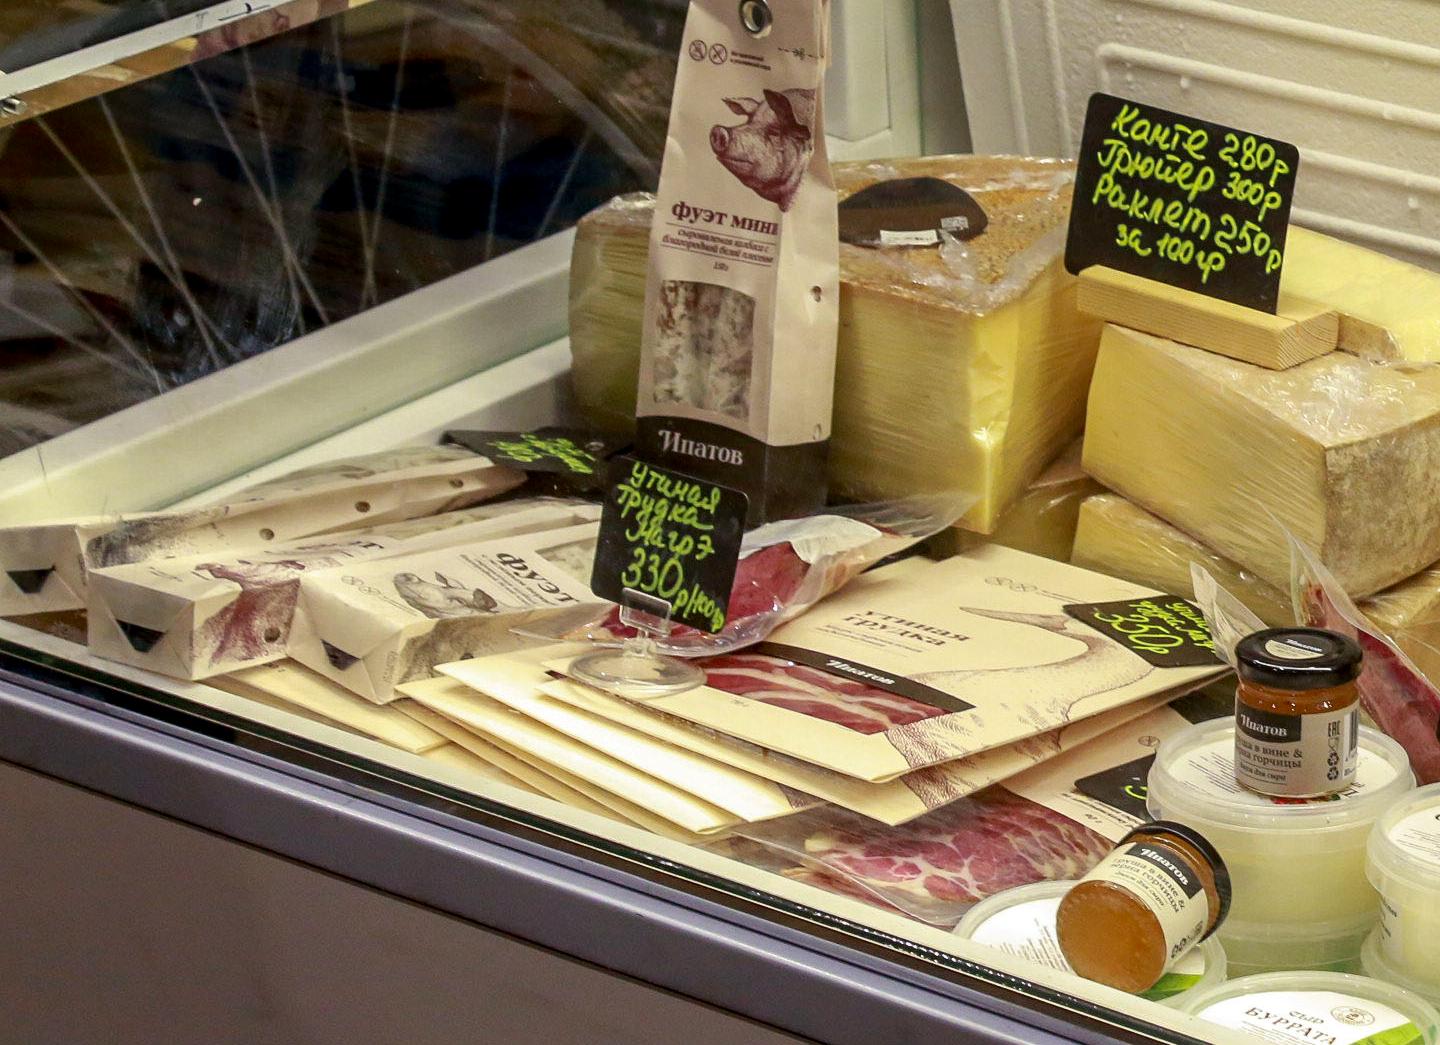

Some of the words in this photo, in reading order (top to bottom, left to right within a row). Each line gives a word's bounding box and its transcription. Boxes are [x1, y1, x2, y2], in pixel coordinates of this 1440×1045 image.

[1219, 133, 1290, 187] 280р
[671, 201, 728, 224] фуэт
[1222, 172, 1281, 222] 300р
[1116, 224, 1151, 256] за
[1157, 233, 1225, 284] 100гр
[1214, 214, 1281, 274] 250р
[658, 429, 744, 466] Ипатов
[496, 552, 580, 603] фуэт
[826, 659, 896, 685] Ипатов
[1240, 714, 1288, 737] Ипатов
[1253, 753, 1302, 769] горчицы
[1262, 747, 1289, 758] вине
[1293, 749, 1302, 759] &
[1140, 848, 1188, 886] Ипатов
[1157, 873, 1179, 897] вине
[1142, 871, 1180, 913] горчицы
[1245, 1007, 1337, 1045] БУРРАТА
